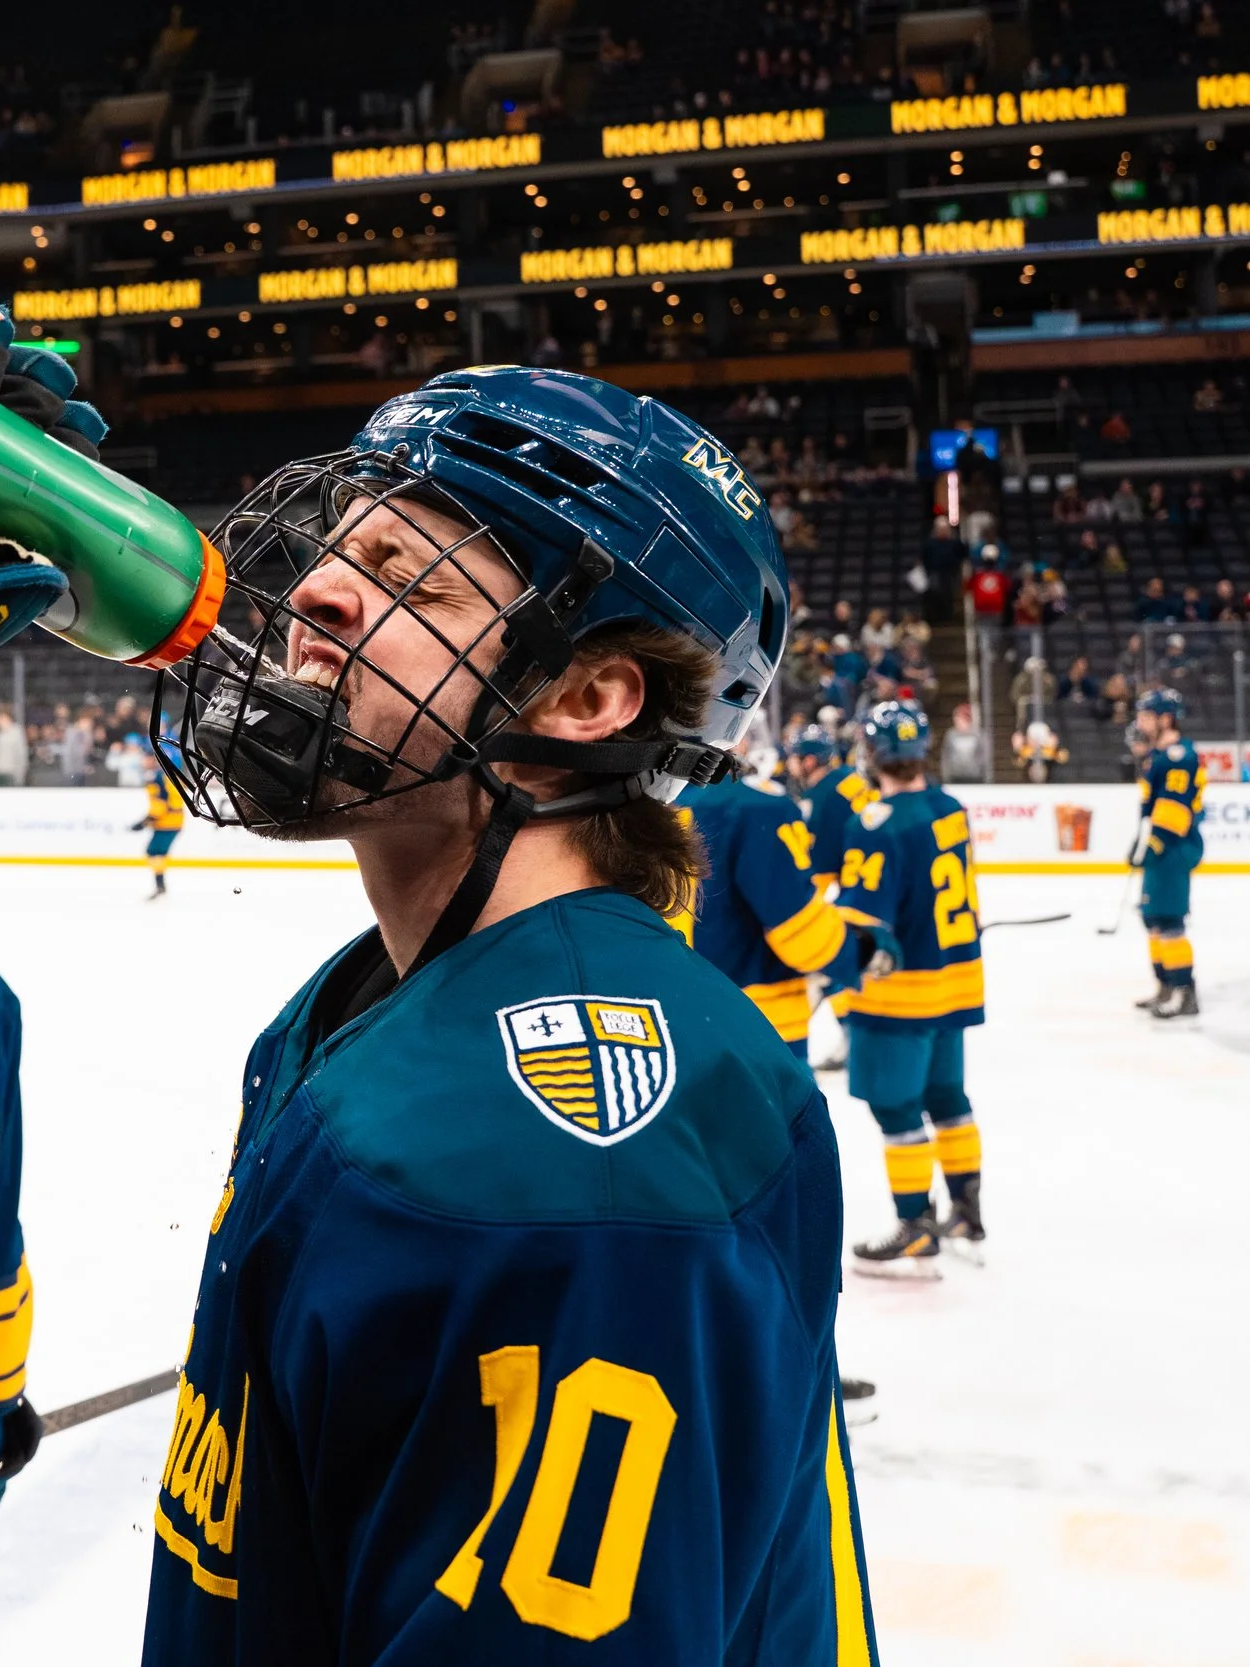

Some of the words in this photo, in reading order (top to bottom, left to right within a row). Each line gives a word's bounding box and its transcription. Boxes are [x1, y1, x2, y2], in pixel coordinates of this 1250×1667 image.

[890, 94, 994, 134] MORGAN
[1021, 83, 1126, 124] MORGAN
[1197, 73, 1250, 110] MOR
[602, 119, 700, 158] MORGAN
[724, 108, 825, 148] MORGAN
[332, 144, 424, 181] MORGAN
[445, 133, 541, 170] MORGAN
[800, 226, 899, 264] MORGAN
[924, 218, 1025, 254] MORGAN
[1097, 206, 1201, 245] MORGAN
[520, 246, 614, 283] MORGAN
[637, 238, 733, 275] MORGAN
[370, 405, 450, 428] CCM
[681, 437, 762, 521] MC
[840, 848, 886, 891] 24
[434, 1344, 678, 1642] 10
